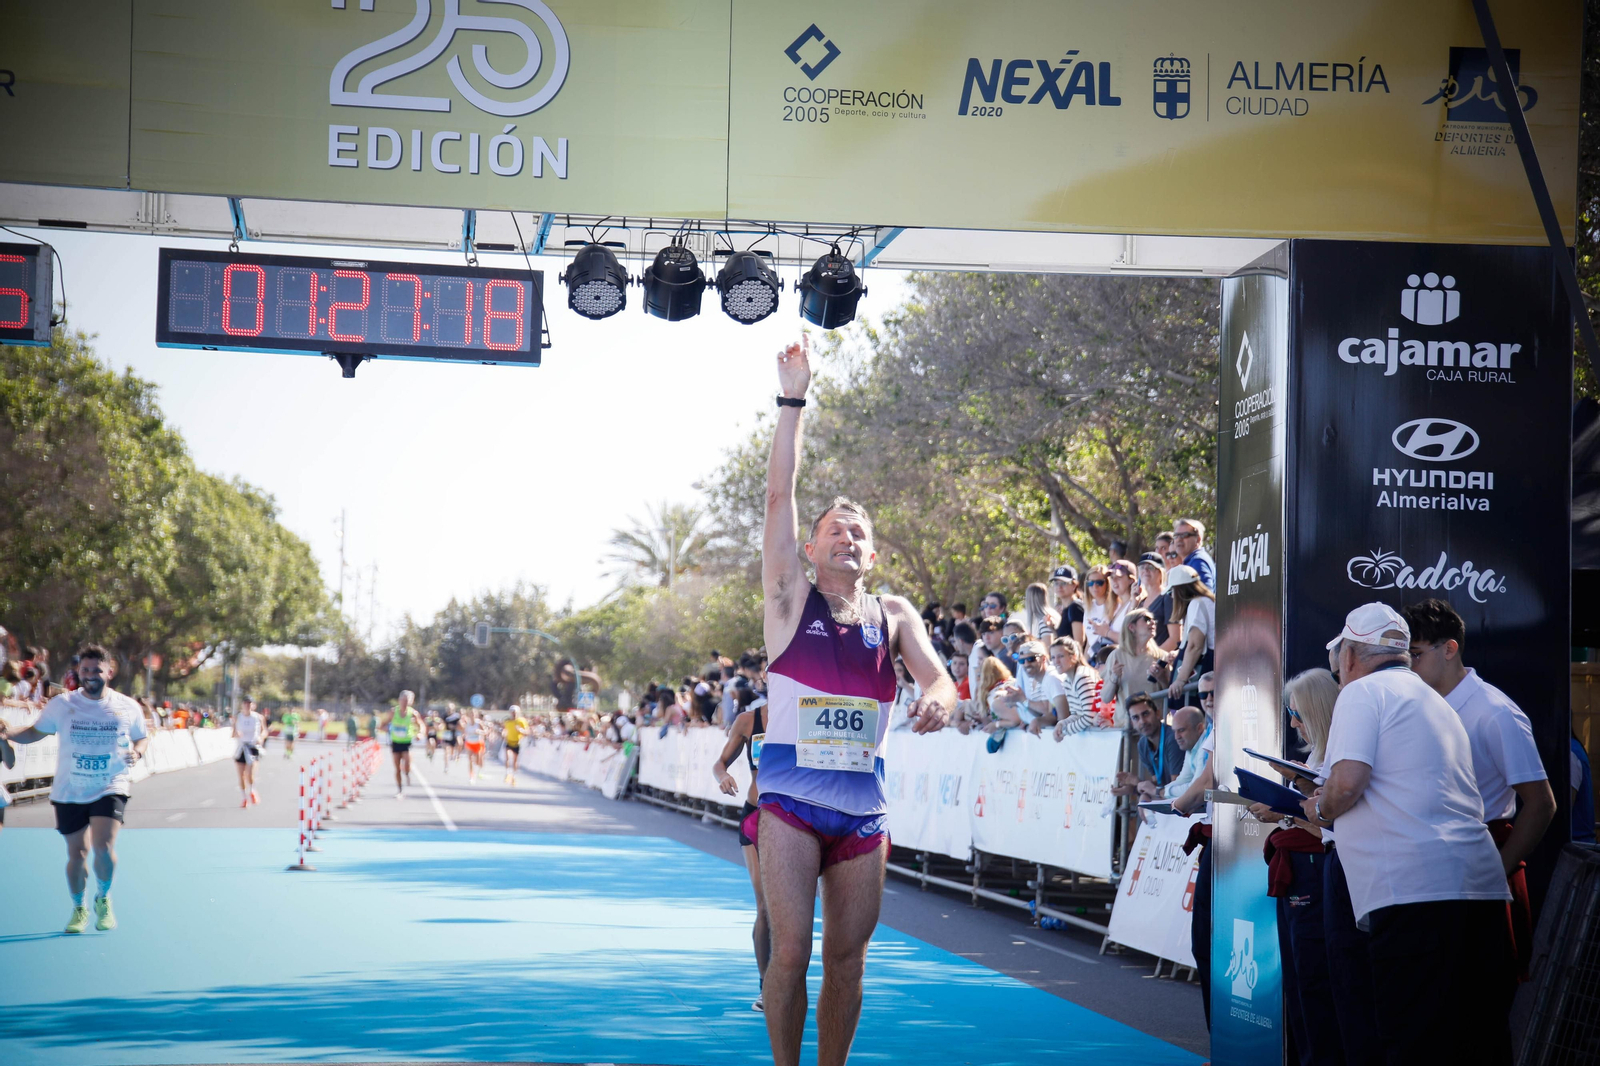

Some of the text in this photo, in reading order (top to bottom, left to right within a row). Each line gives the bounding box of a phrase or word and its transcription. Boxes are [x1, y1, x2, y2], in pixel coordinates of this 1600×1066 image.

[329, 0, 570, 117] 25
[1226, 56, 1391, 94] ALMERÍA
[783, 86, 924, 110] COOPERACIÓN
[1226, 96, 1309, 117] CIUDAD
[782, 105, 830, 123] 2005
[834, 107, 927, 120] Deporte, ocio y cultura
[971, 105, 1003, 118] 2020
[1434, 132, 1501, 143] DEPORTES
[328, 123, 569, 179] EDICIÓN
[1337, 327, 1522, 376] cajamar
[1426, 369, 1516, 384] CAJA RURAL
[1372, 467, 1494, 490] HYUNDAI
[1376, 490, 1490, 511] Almerialva
[815, 708, 864, 732] 486
[76, 758, 107, 771] 5883
